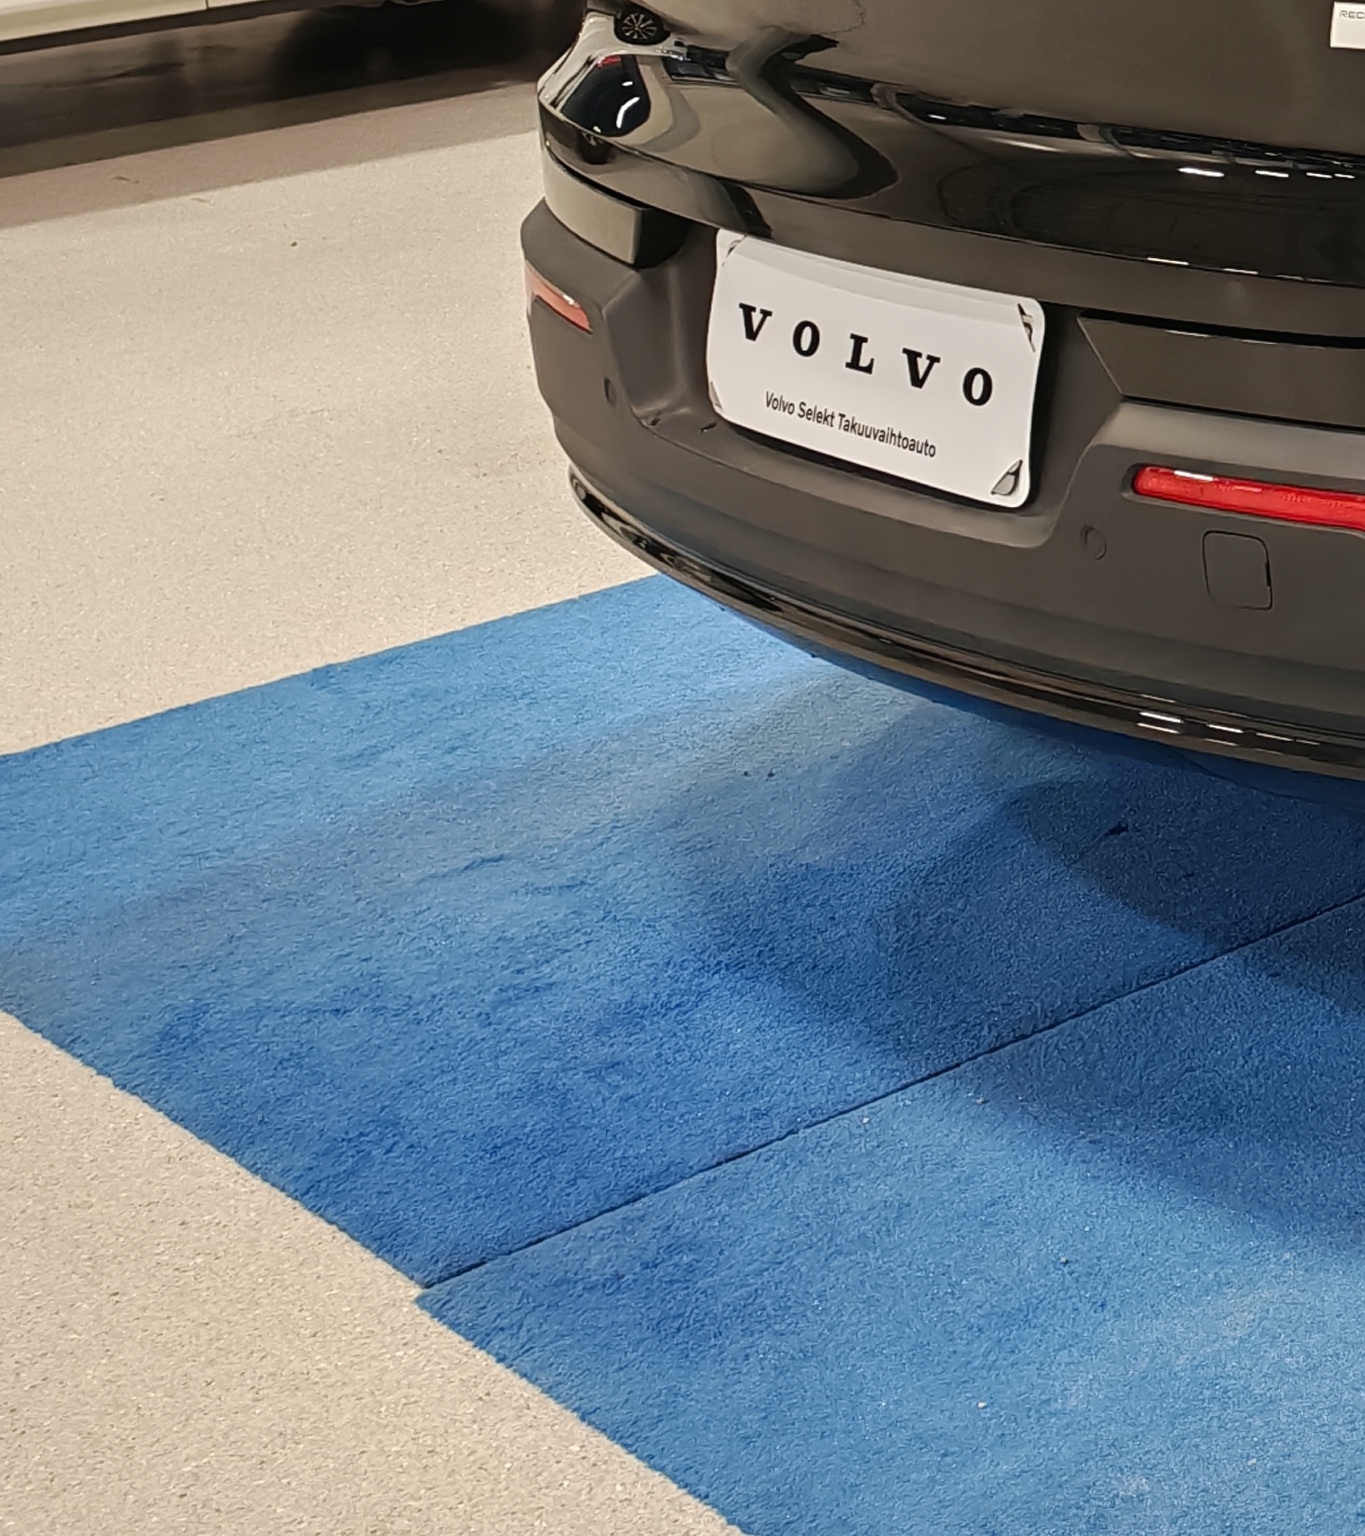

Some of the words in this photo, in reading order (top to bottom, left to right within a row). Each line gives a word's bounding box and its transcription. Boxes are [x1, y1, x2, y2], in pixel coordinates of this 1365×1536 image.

[739, 302, 993, 407] VOLVO
[765, 391, 795, 416] Volvo
[797, 401, 836, 428] Selekt
[837, 413, 937, 458] Takuuvaihtoauto
